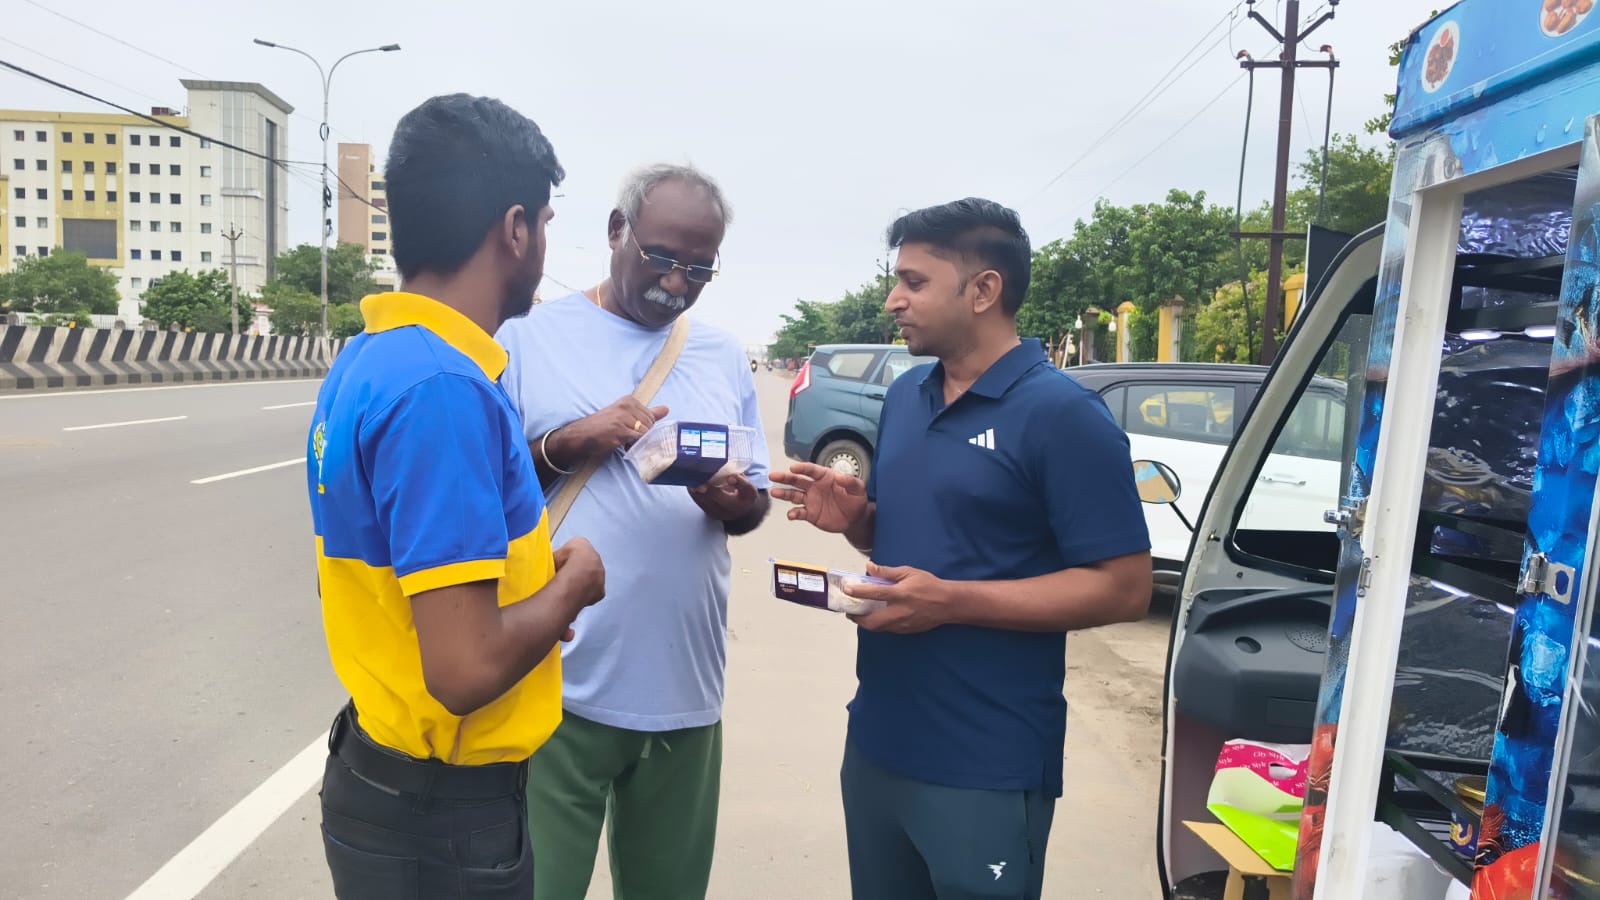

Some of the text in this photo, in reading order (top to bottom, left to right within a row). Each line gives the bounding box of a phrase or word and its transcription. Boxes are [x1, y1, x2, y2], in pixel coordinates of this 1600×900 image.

[1253, 751, 1285, 761] City Style
[1251, 761, 1267, 769] Style
